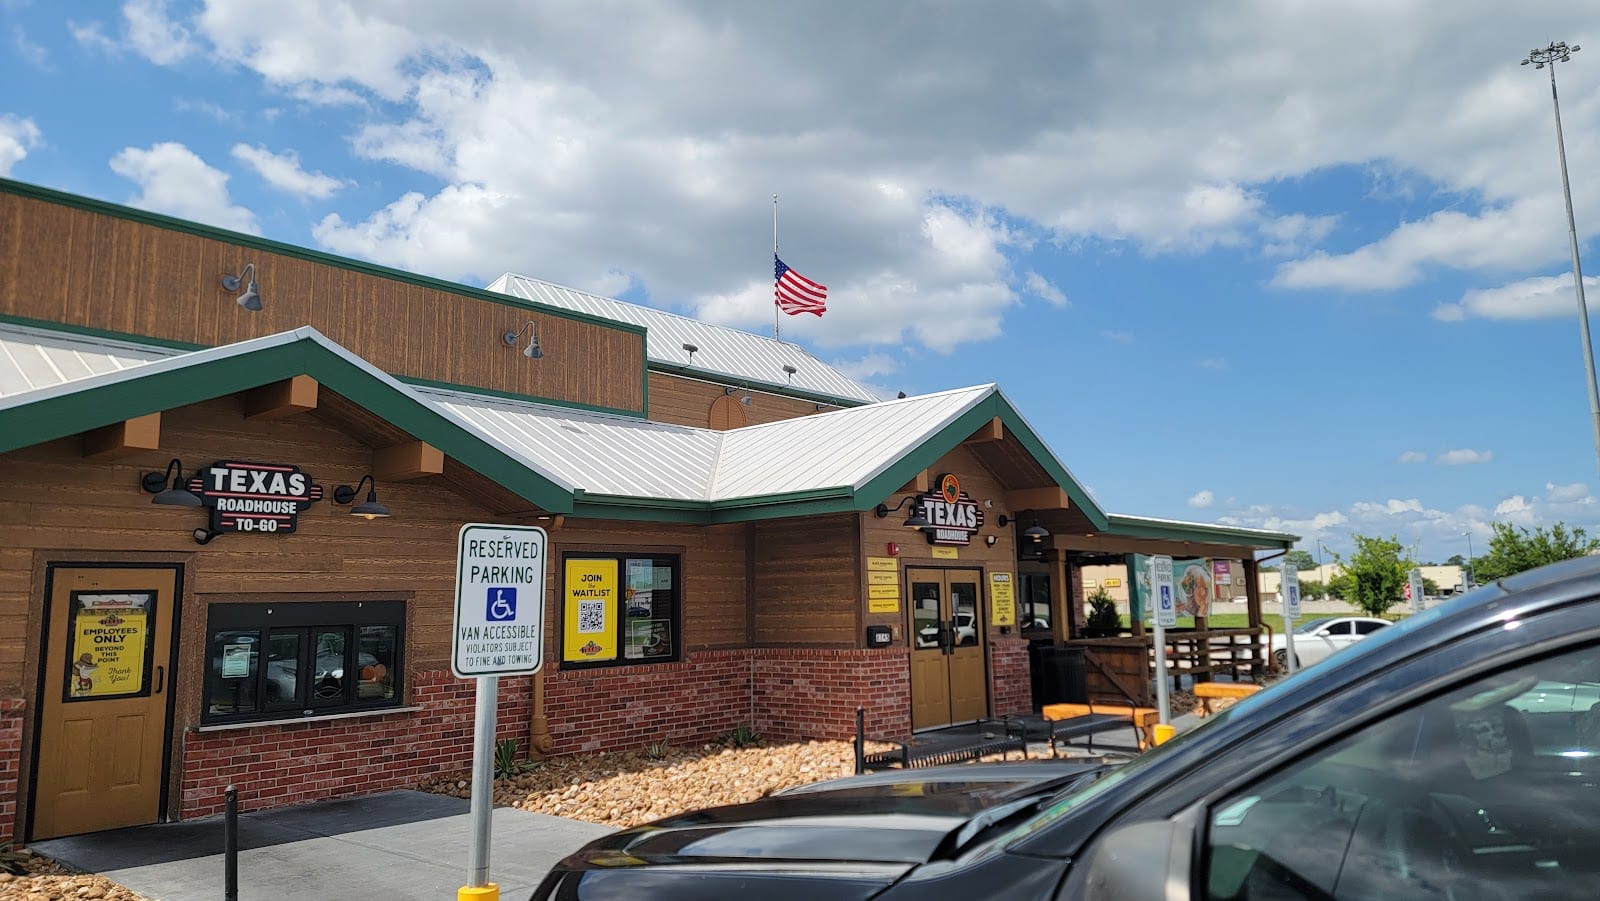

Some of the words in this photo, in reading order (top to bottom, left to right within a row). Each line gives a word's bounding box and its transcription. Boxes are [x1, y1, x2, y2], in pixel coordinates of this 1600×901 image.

[210, 467, 306, 496] TEXAS
[216, 498, 297, 514] ROADHOUSE
[924, 500, 977, 528] TEXAS
[236, 518, 278, 532] TO-GO
[936, 528, 969, 541] ROADHOUSE
[469, 540, 539, 559] RESERVED
[470, 565, 534, 584] PARKING
[581, 574, 603, 582] JOIN
[572, 589, 611, 598] WAITLIST
[84, 627, 138, 635] EMPLOYEES
[461, 626, 480, 641] VAN
[483, 624, 536, 640] ACCESSIBLE
[94, 635, 125, 643] ONLY
[466, 642, 503, 654] VIOLATORS
[504, 641, 533, 653] SUBJECT
[465, 656, 474, 667] TO
[475, 656, 491, 667] FINE
[493, 655, 506, 666] AND
[508, 653, 533, 665] TOWING
[108, 666, 132, 674] Thank
